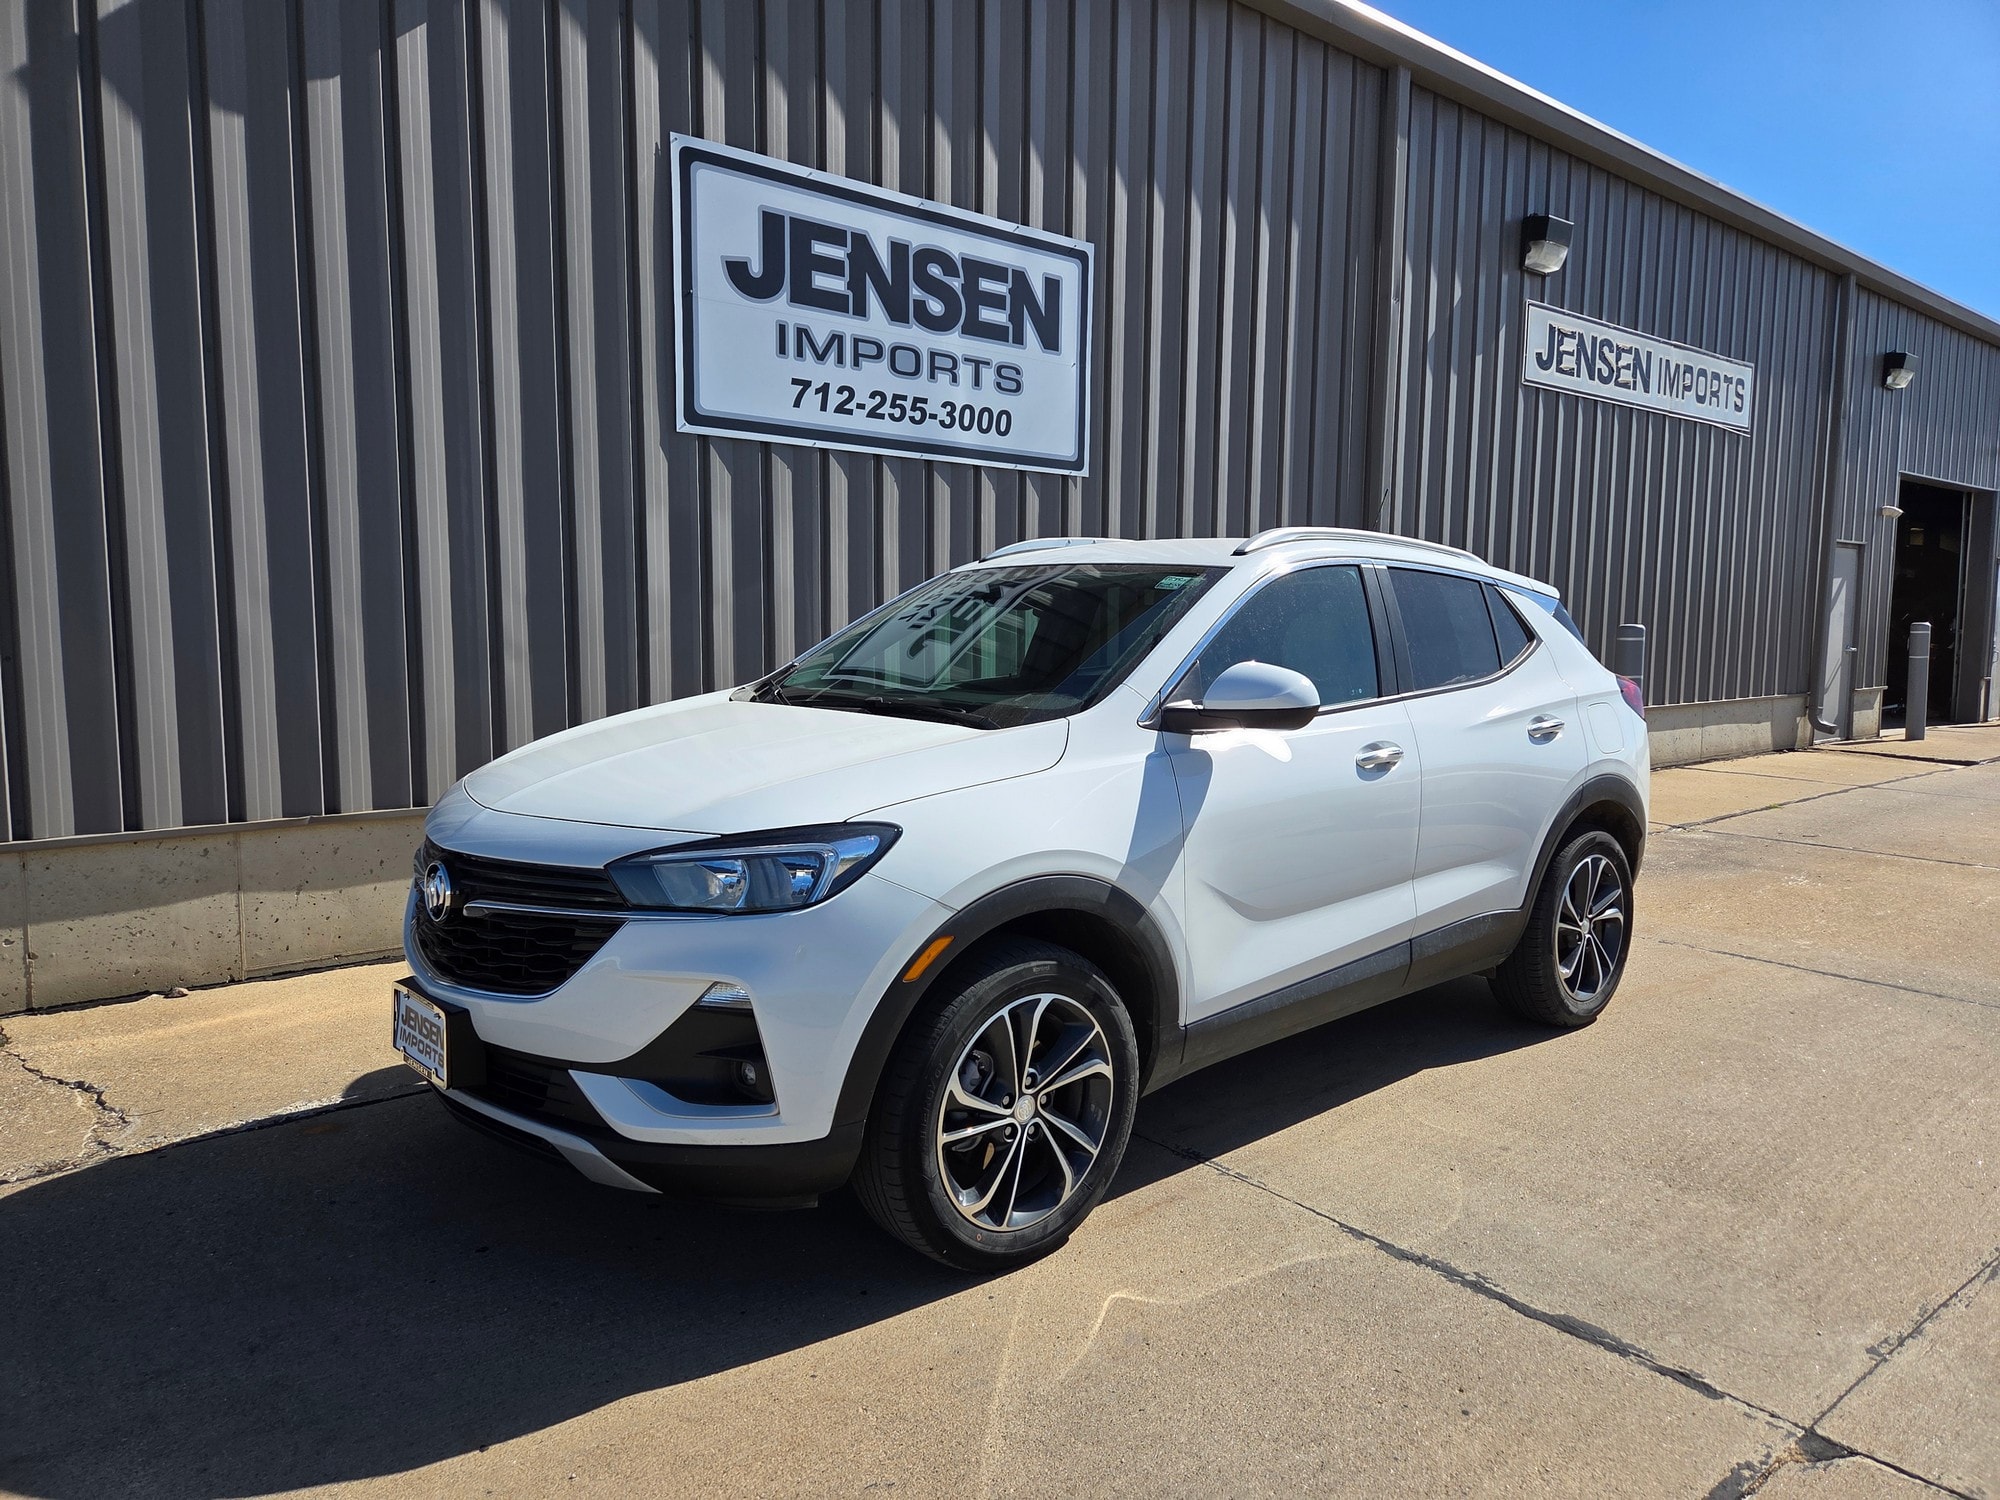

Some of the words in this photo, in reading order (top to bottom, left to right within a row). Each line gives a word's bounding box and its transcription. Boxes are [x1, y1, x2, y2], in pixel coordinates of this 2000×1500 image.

[721, 204, 1063, 356] JENSEN
[775, 319, 1024, 396] IMPORTS
[1535, 323, 1653, 394] JENSEN
[1657, 357, 1745, 413] IMPORTS
[790, 377, 1013, 438] 712-255-3000
[399, 1026, 445, 1069] IMPORTS
[401, 1004, 445, 1052] JENSEN
